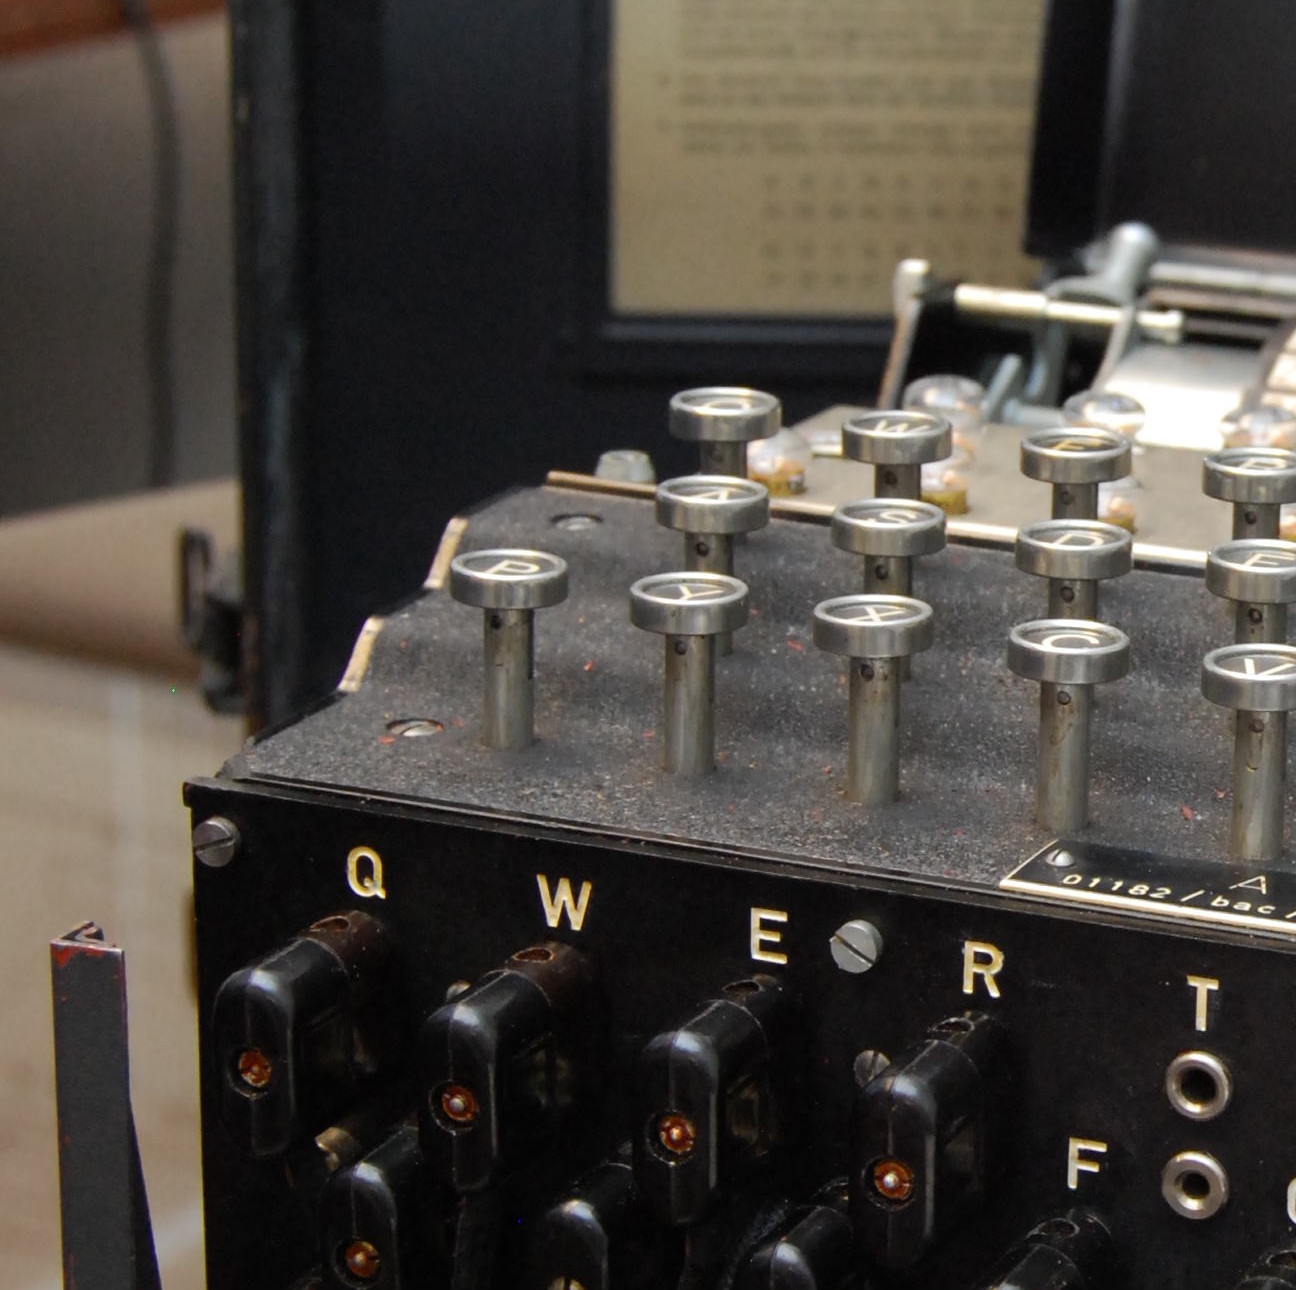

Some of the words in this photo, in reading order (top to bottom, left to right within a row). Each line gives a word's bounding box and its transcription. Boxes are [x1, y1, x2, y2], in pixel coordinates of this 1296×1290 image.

[1228, 873, 1268, 896] A
[347, 847, 387, 899] Q
[537, 874, 592, 931] W
[750, 908, 788, 964] E
[963, 942, 1004, 999] R
[1187, 976, 1219, 1031] T
[1067, 1139, 1108, 1189] F
